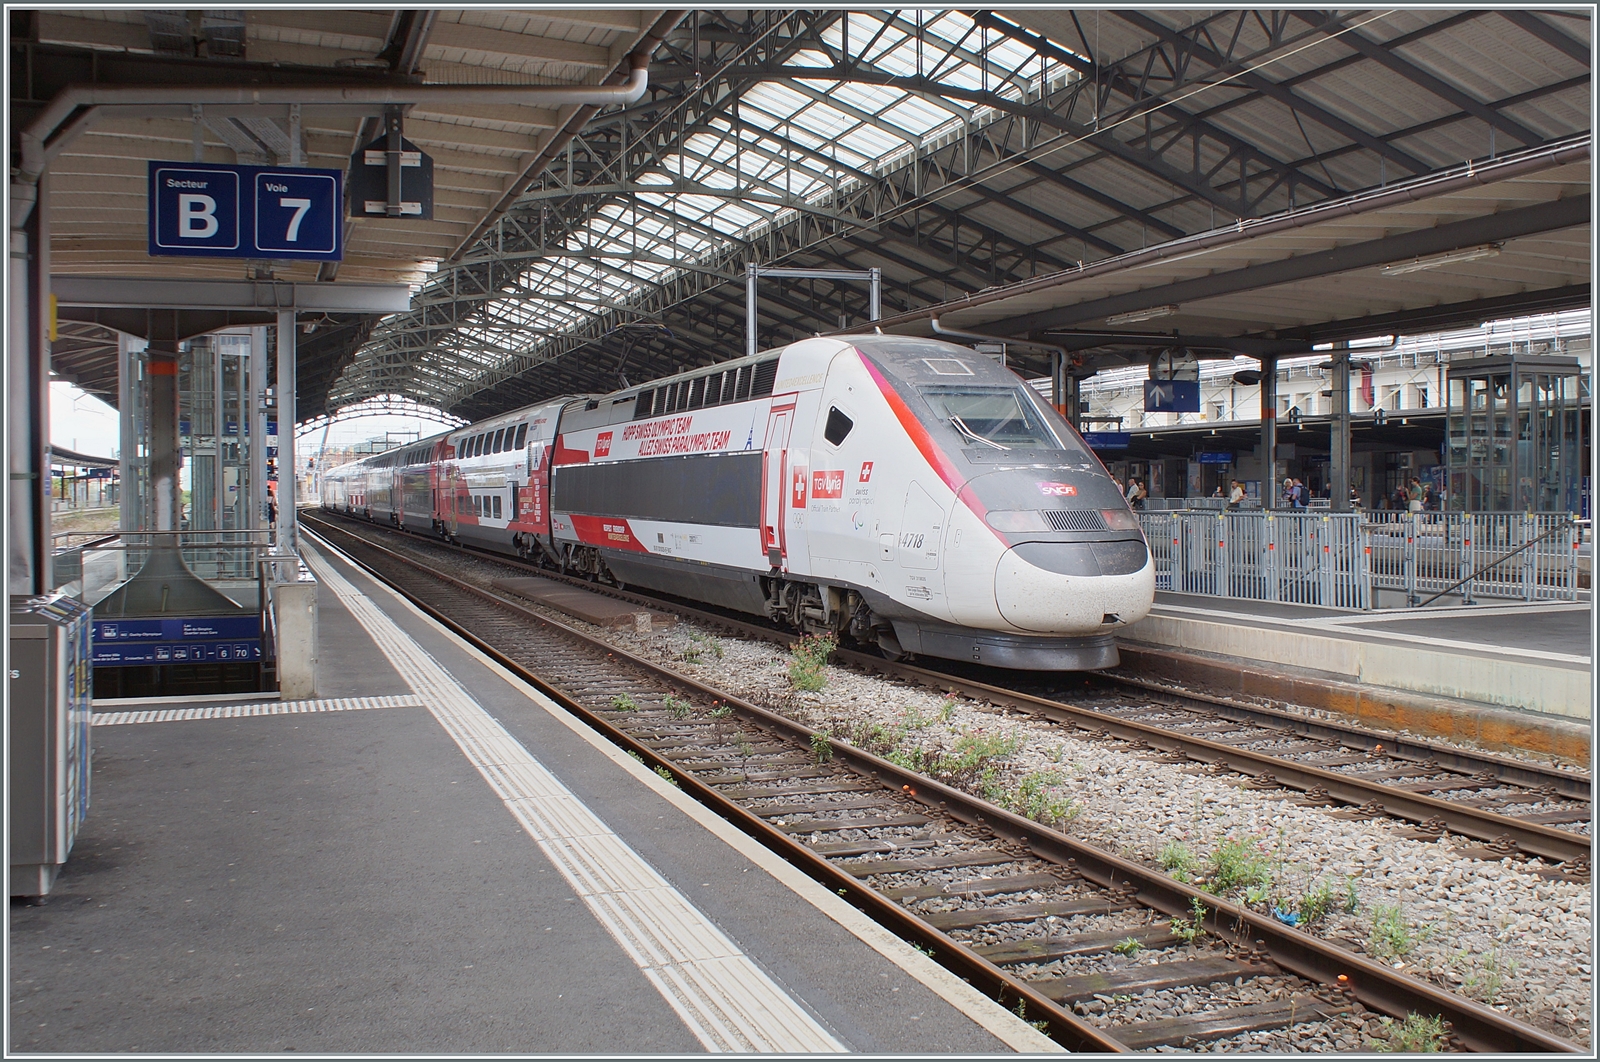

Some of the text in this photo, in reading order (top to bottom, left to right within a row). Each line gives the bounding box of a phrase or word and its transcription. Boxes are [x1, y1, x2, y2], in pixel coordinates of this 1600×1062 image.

[166, 178, 208, 190] Secteur
[265, 182, 289, 193] Voie
[179, 193, 219, 239] B
[280, 197, 311, 242] 7
[621, 415, 693, 441] HOPP SWISS OLYMPIC TEAM
[637, 430, 731, 456] ALLEZ SWISS PARALYMPIC TEAM
[1041, 486, 1073, 495] SNCF
[901, 532, 925, 549] 4718
[195, 650, 201, 658] 1
[220, 649, 228, 658] 6
[235, 649, 247, 657] 70
